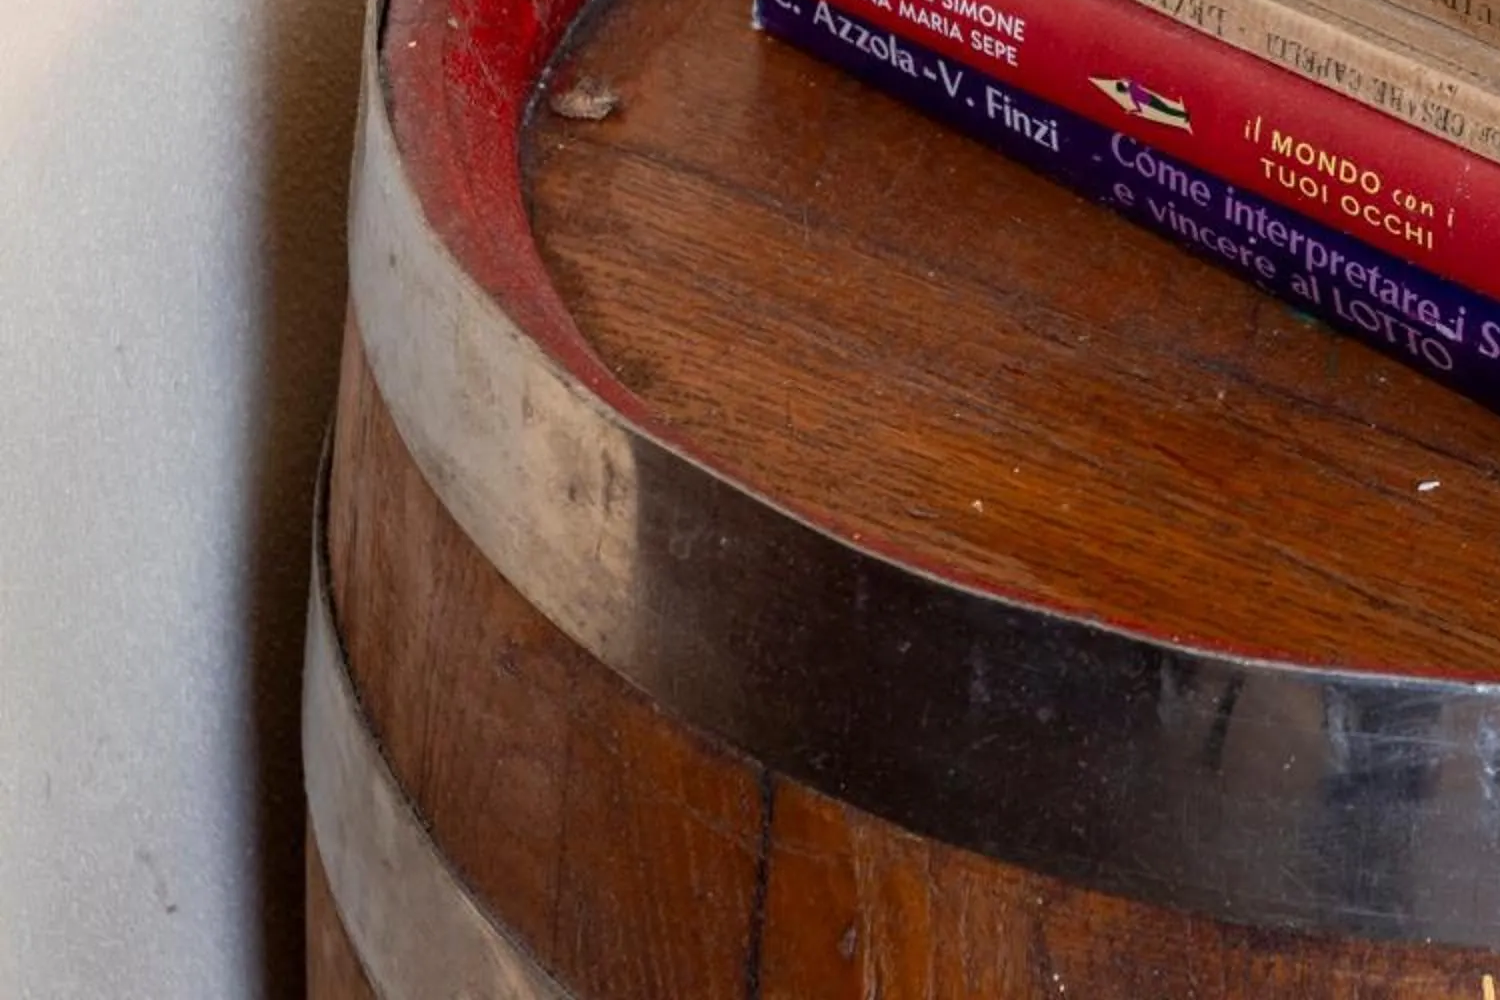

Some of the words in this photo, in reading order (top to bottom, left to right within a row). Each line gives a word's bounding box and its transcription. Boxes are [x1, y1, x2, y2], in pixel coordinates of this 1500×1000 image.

[899, 0, 965, 43] MARIA
[970, 30, 1019, 67] SEPE
[1266, 32, 1361, 90] CAPELLI
[985, 85, 1060, 152] Finzi
[1244, 115, 1262, 144] il
[1271, 130, 1380, 194] MONDO
[1392, 189, 1434, 217] con
[1447, 207, 1456, 228] i
[1260, 157, 1328, 204] TUOI
[1341, 195, 1434, 250] OCCHI
[1111, 132, 1212, 207] Come
[1225, 187, 1440, 326] interpretare
[1455, 305, 1466, 342] i
[1113, 183, 1135, 206] e
[1147, 196, 1277, 279] vincere
[1290, 272, 1321, 304] al
[1333, 286, 1453, 371] LOTTO
